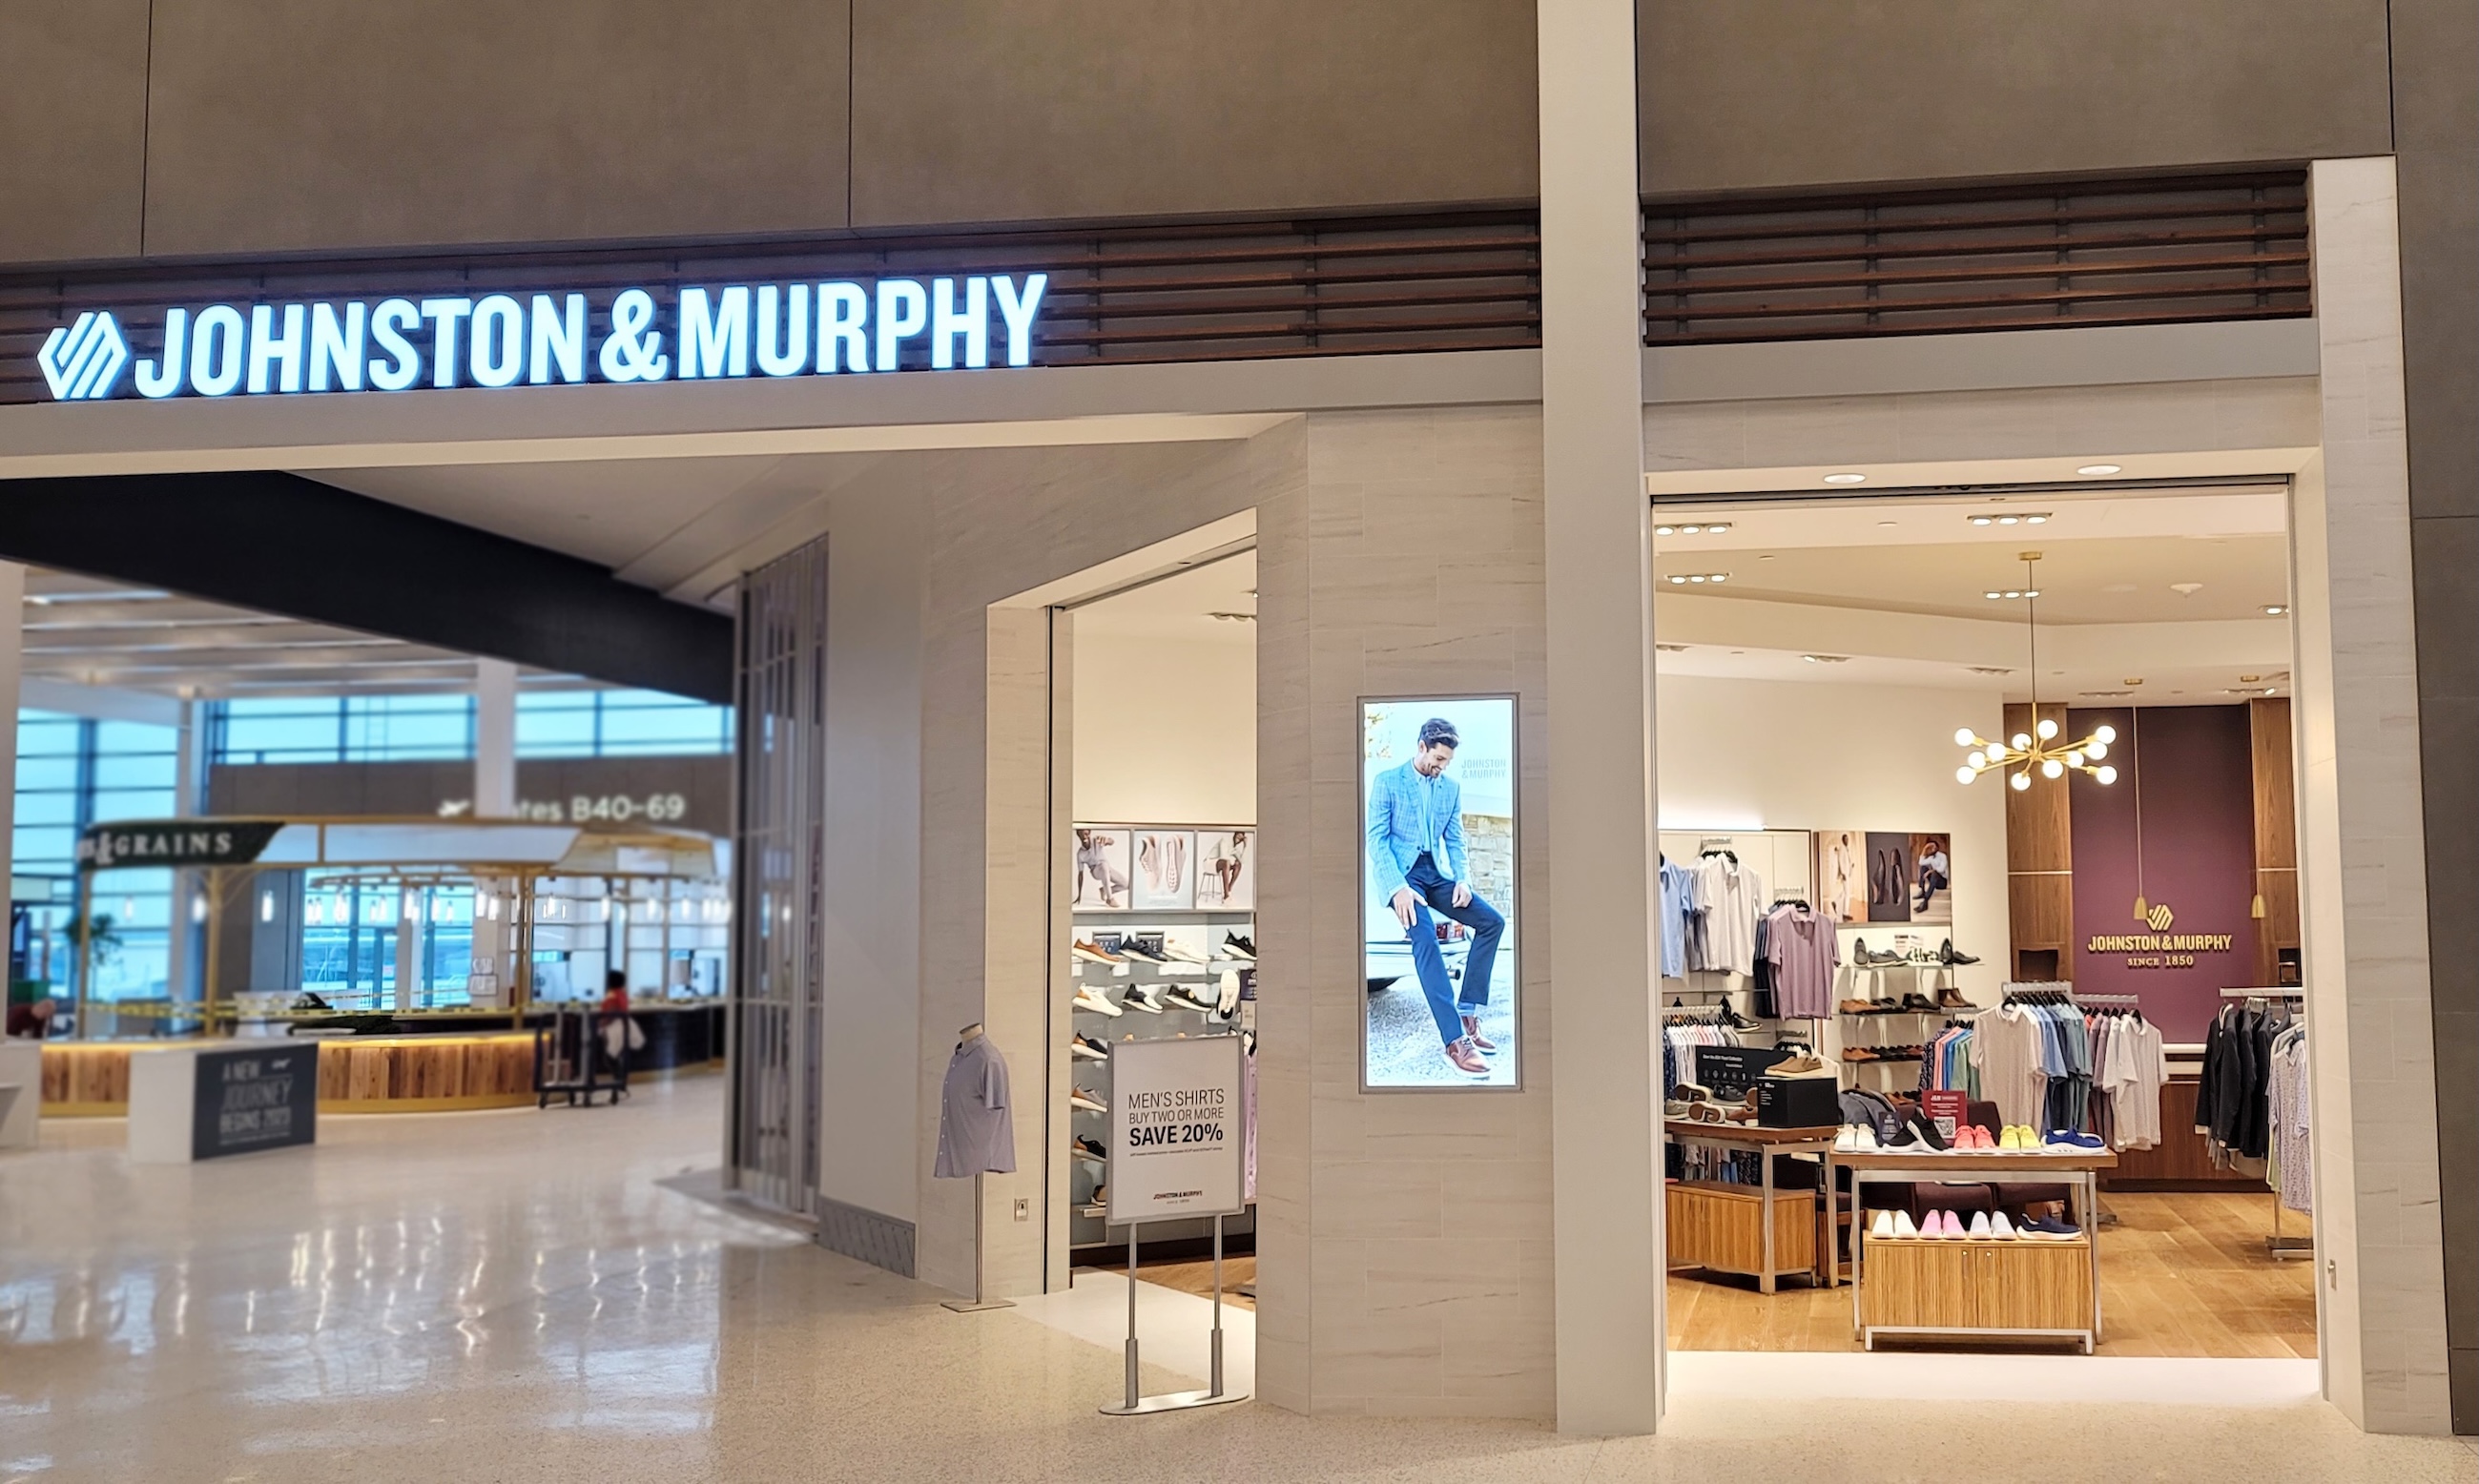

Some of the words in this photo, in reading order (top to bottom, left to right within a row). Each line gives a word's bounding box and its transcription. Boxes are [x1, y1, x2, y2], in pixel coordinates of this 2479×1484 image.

[134, 293, 586, 399] JOHNSTON
[598, 288, 669, 383] &
[677, 273, 1048, 380] MURPHY
[1461, 758, 1506, 769] JOHNSTON
[511, 801, 563, 821] tes
[571, 794, 686, 821] B40-69
[2088, 936, 2160, 952] JOHNSTON
[2174, 934, 2232, 951] MURPHY
[2127, 958, 2159, 966] SINCE
[2165, 955, 2194, 965] 1850
[1128, 1091, 1172, 1109] MEN'S
[1175, 1088, 1224, 1106] SHIRTS
[1129, 1112, 1149, 1124] BUY
[1151, 1109, 1175, 1123] TWO
[1177, 1109, 1192, 1122] OR
[1194, 1106, 1224, 1121] MORE
[1129, 1125, 1178, 1146] SAVE
[1182, 1123, 1223, 1144] 20%
